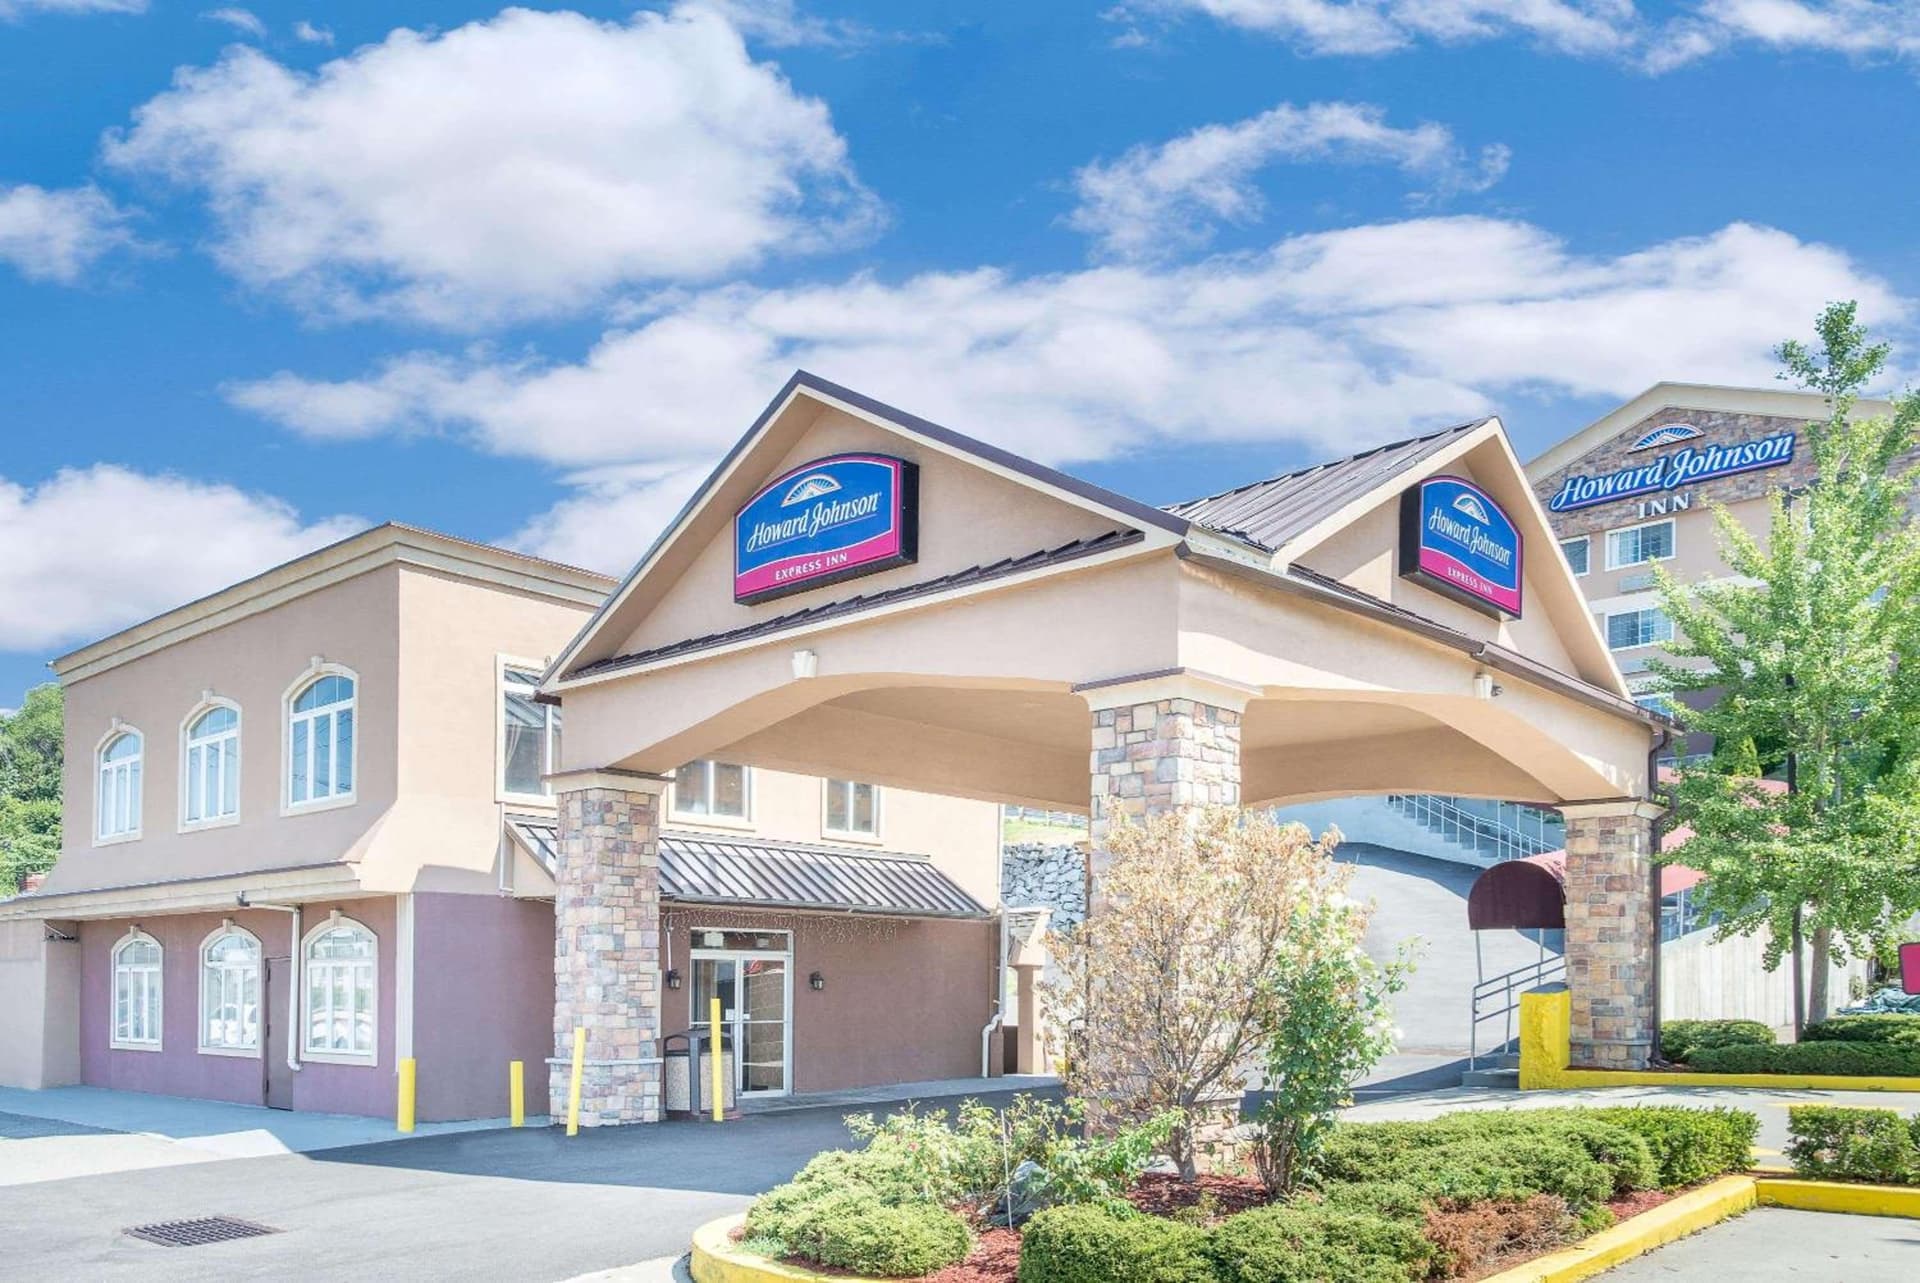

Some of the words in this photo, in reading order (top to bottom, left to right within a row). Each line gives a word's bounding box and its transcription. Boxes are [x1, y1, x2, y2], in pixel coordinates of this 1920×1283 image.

[1551, 457, 1666, 510] Howard
[1665, 433, 1795, 489] Johnson
[747, 509, 808, 552] Howard
[809, 493, 879, 537] Johnson
[1638, 493, 1690, 519] INN
[1428, 507, 1471, 544] Howard
[1469, 526, 1510, 566] Johnson
[775, 560, 822, 581] EXPRESS
[826, 553, 848, 567] INN
[1447, 567, 1478, 589] EXPRESS
[1480, 581, 1493, 594] INN
